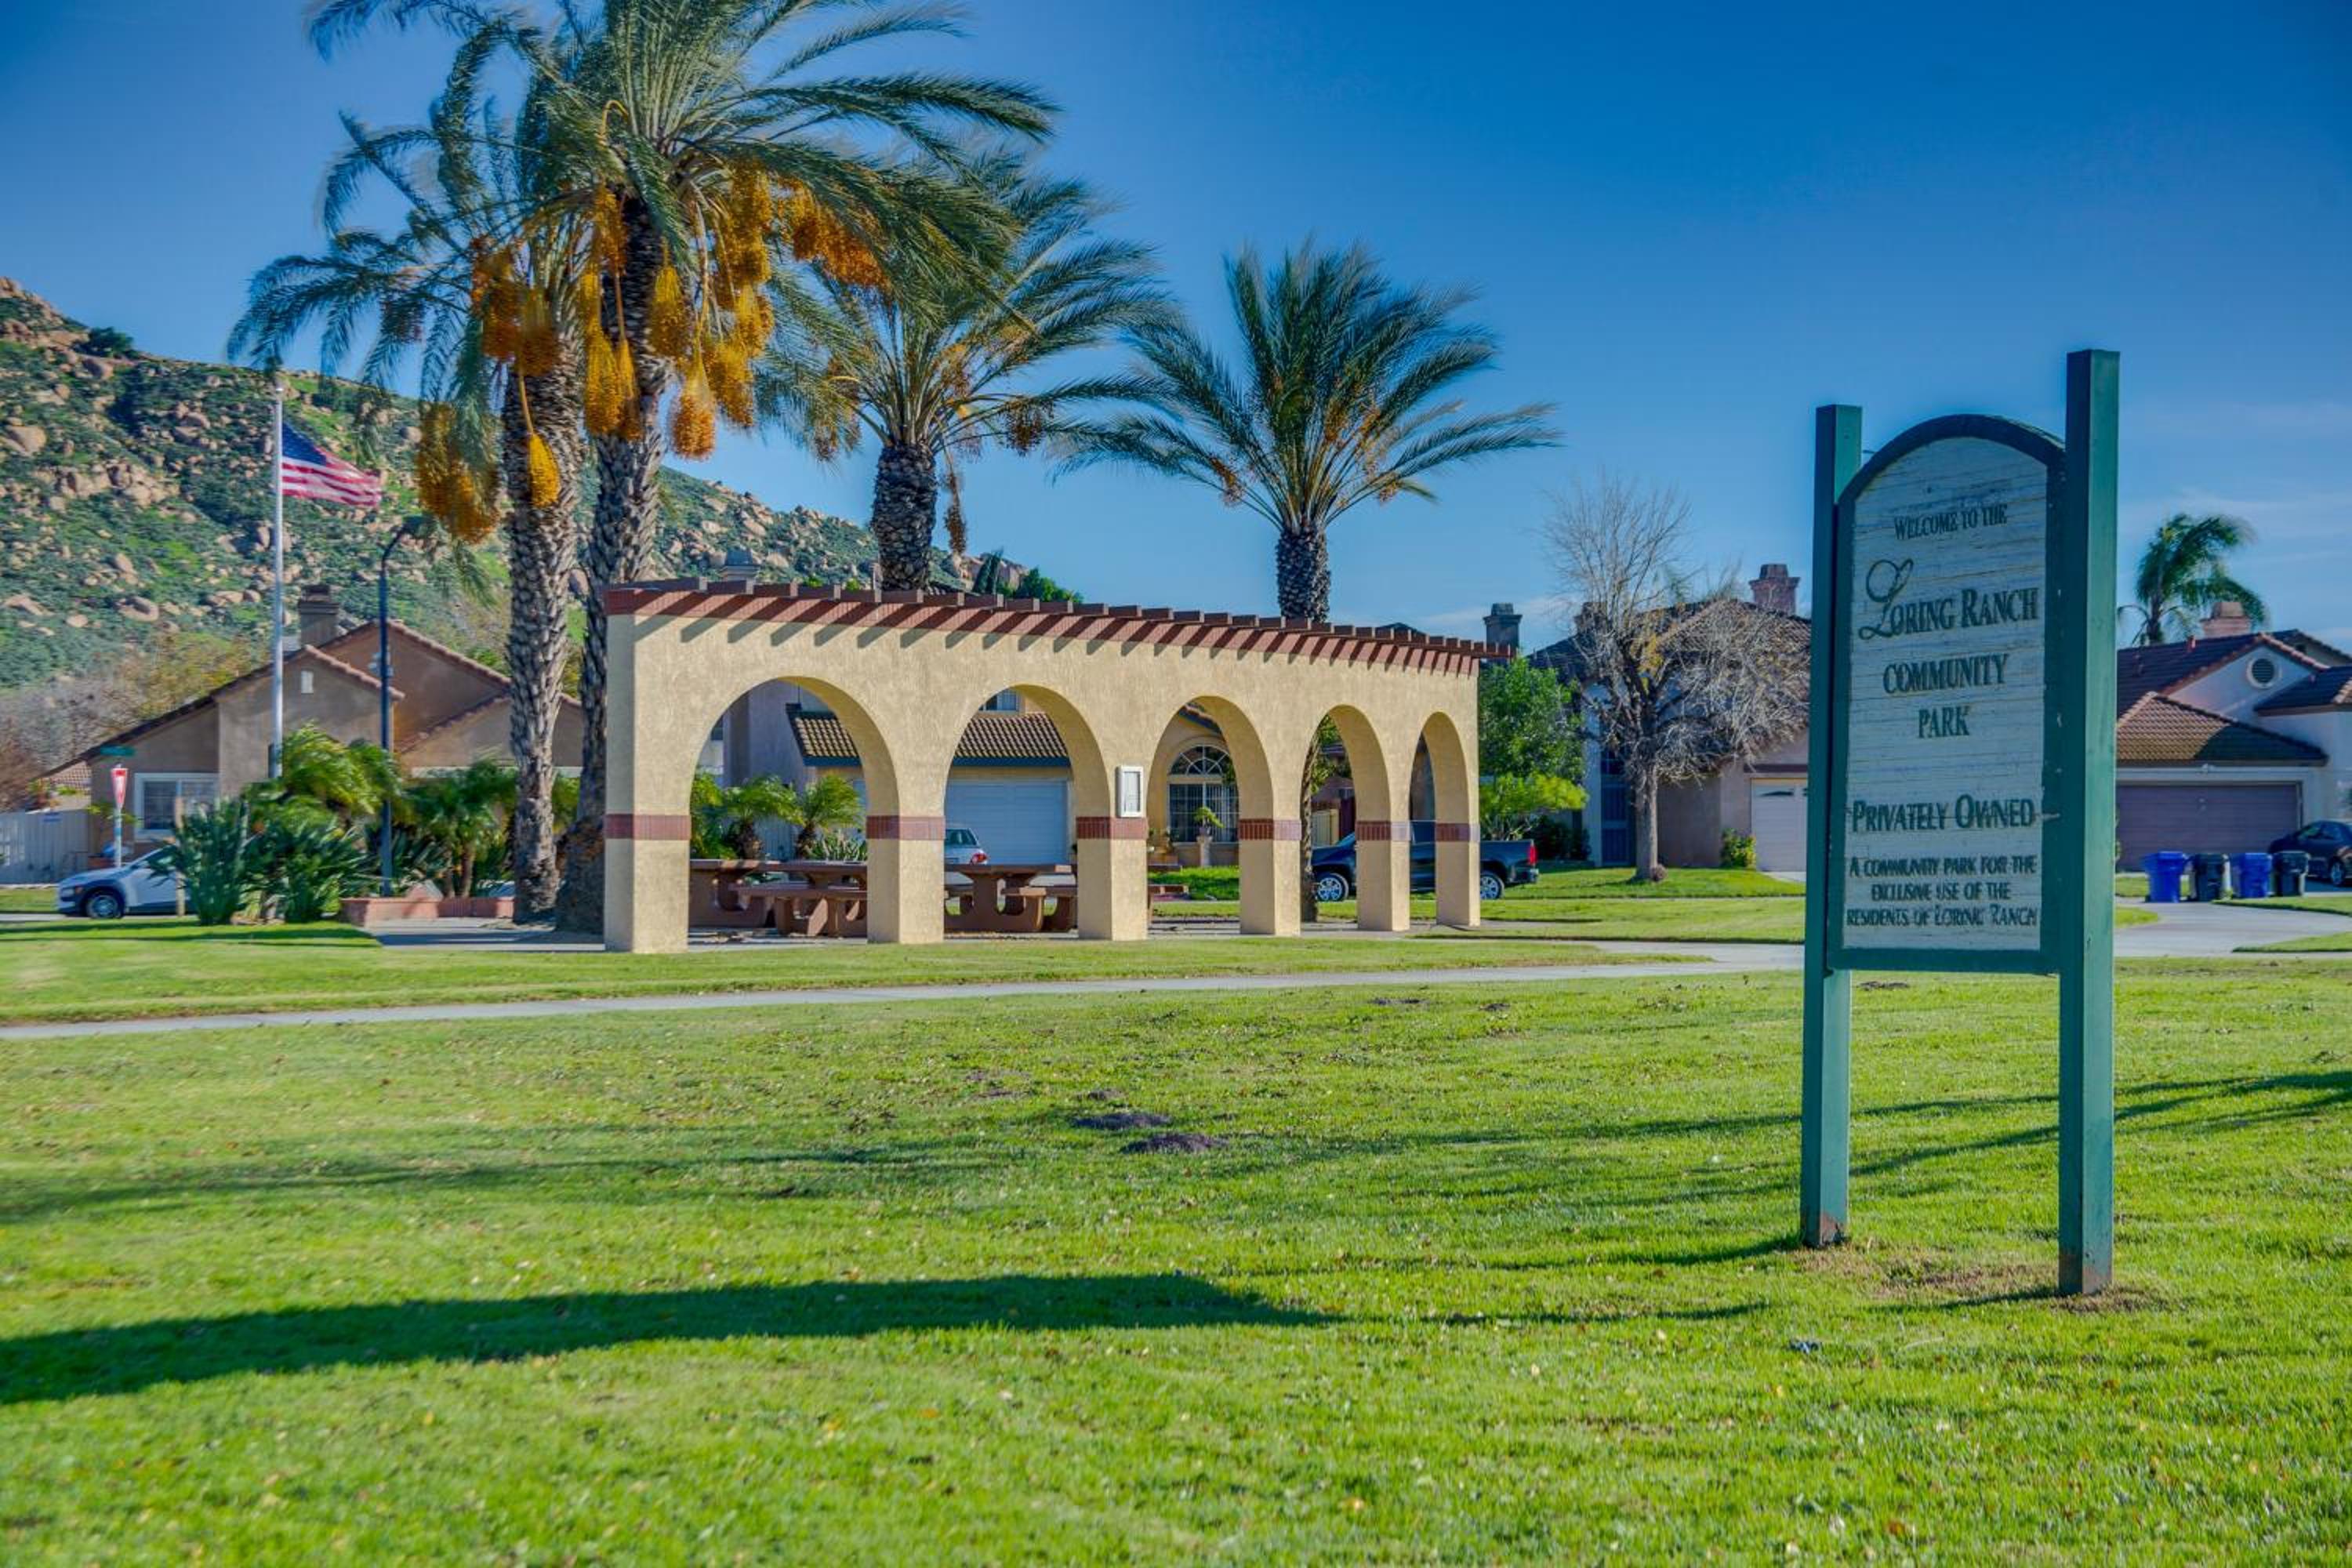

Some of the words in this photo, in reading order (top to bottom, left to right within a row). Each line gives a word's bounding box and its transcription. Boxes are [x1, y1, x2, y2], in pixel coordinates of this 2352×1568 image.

[1894, 511, 1958, 539] WELCOME
[1961, 510, 1977, 529] TO
[1982, 503, 2008, 526] THE
[1858, 559, 1956, 640] LORING
[1962, 588, 2039, 628] RANCH
[1883, 654, 2009, 694] COMMUNITY
[1919, 706, 1970, 738] PARK
[1853, 800, 1947, 832] PRIVATELY
[1955, 794, 2035, 829] OWNED
[1850, 857, 1859, 877] A
[1864, 858, 1940, 876] COMMUNITY
[1944, 857, 1976, 875] PARK
[1981, 855, 2007, 873] FOR
[2012, 855, 2038, 874] THE
[1871, 884, 1932, 901] EXCLUSIVE
[1936, 882, 1959, 900] USE
[1964, 882, 1982, 900] OF
[1985, 882, 2011, 900] THE
[1847, 909, 1910, 926] RESIDENTS
[1914, 909, 1931, 925] OF
[1990, 903, 2038, 926] RANCH
